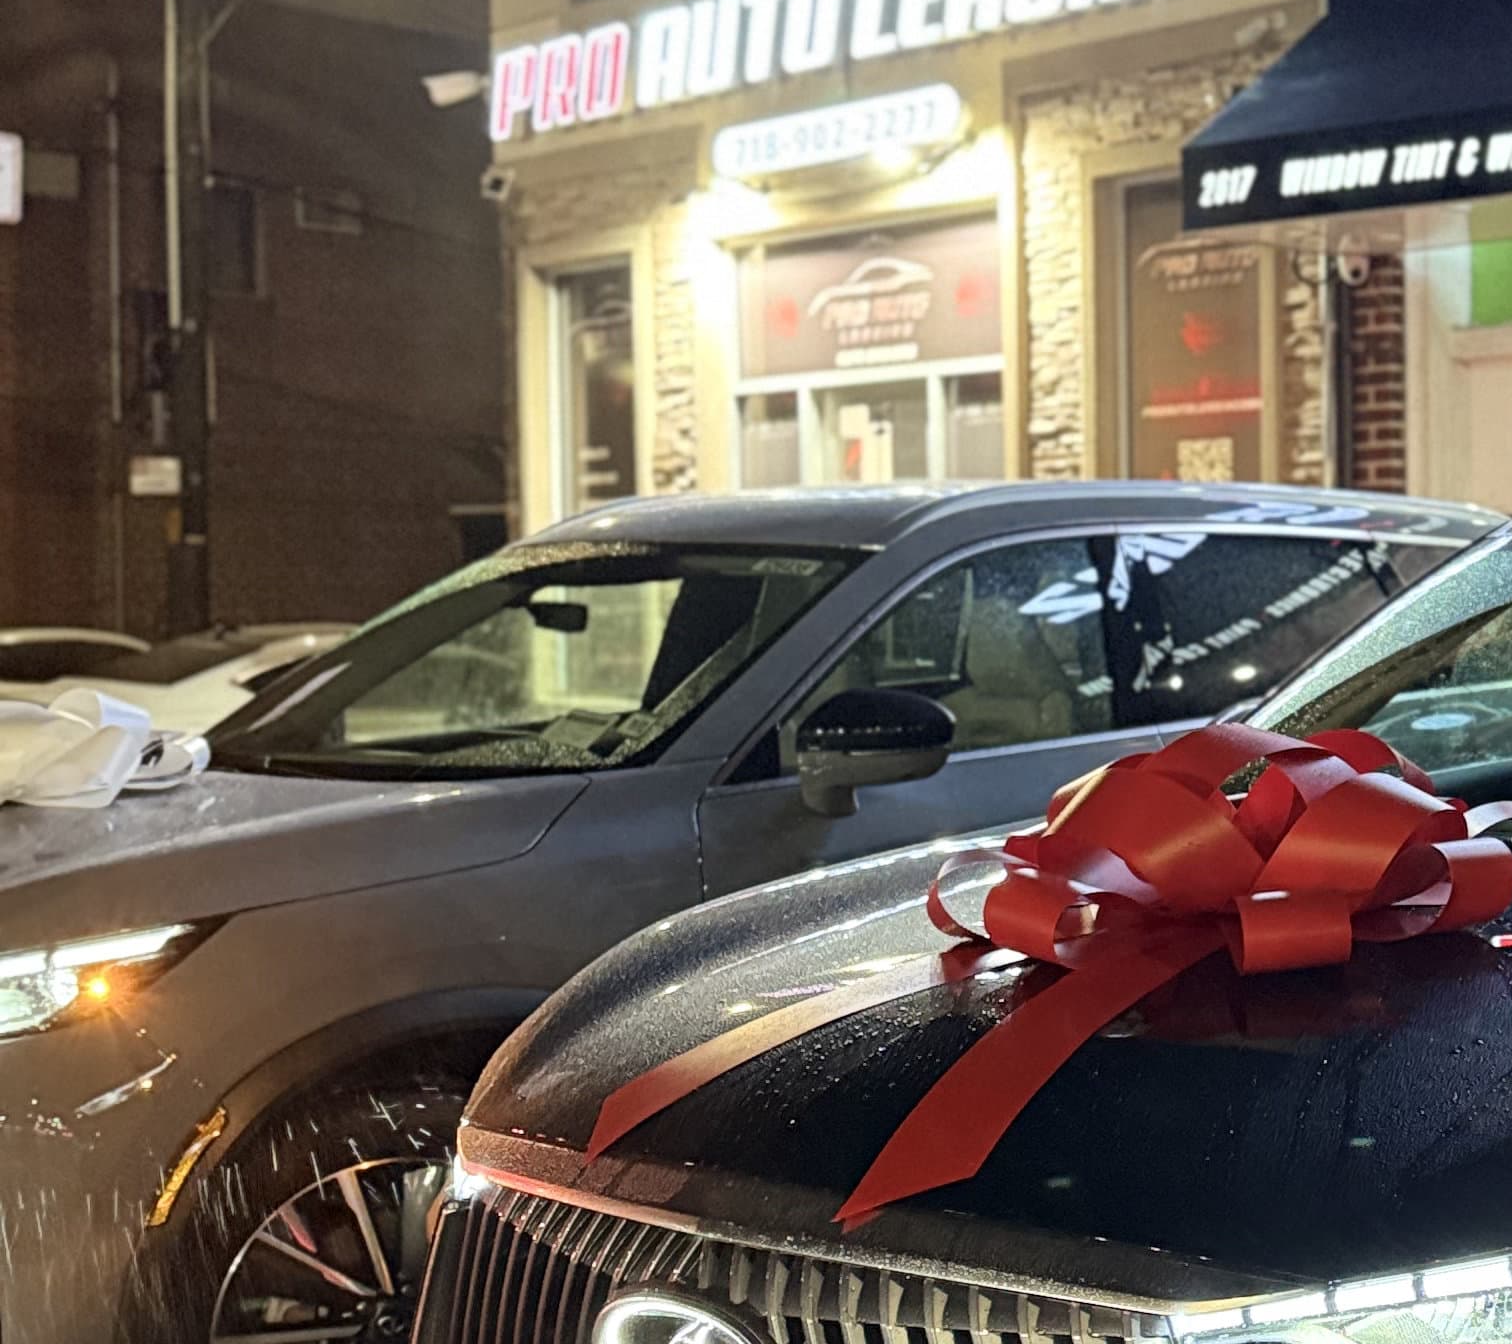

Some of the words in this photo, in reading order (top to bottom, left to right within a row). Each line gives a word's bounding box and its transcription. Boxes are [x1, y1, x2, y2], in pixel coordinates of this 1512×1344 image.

[488, 22, 631, 142] PRO
[1279, 147, 1388, 198] WINDOW
[1389, 139, 1455, 185] TINT
